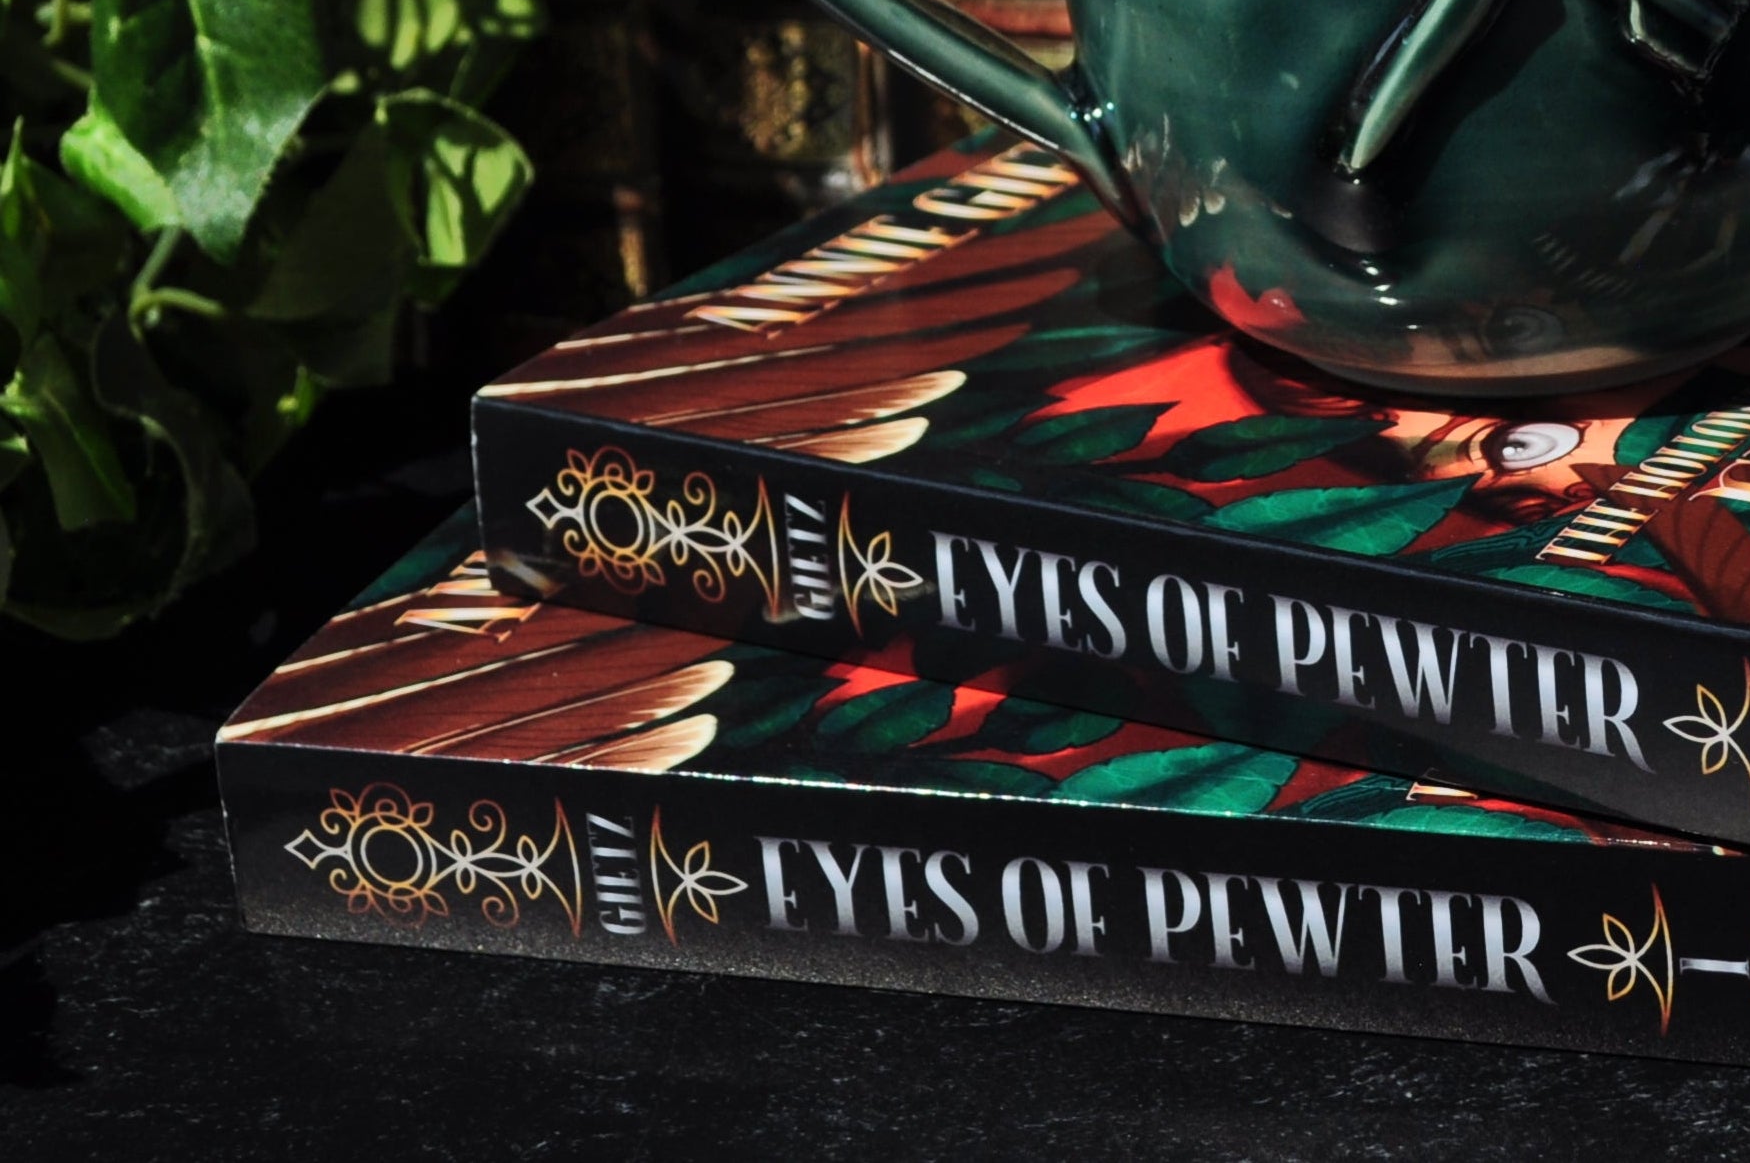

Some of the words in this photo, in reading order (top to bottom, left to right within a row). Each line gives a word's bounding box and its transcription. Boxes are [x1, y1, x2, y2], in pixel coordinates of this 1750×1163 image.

[684, 214, 980, 339] ANNIE
[912, 140, 1081, 221] GIE
[784, 493, 835, 620] GIETZ
[1534, 498, 1658, 564] THE
[928, 530, 1128, 660] EYES
[1147, 573, 1244, 684] OF
[1268, 593, 1657, 775] PEWTER
[586, 813, 647, 936] GIETZ
[754, 836, 981, 947] EYES
[1001, 856, 1111, 956] OF
[1136, 866, 1560, 1006] PEWTER
